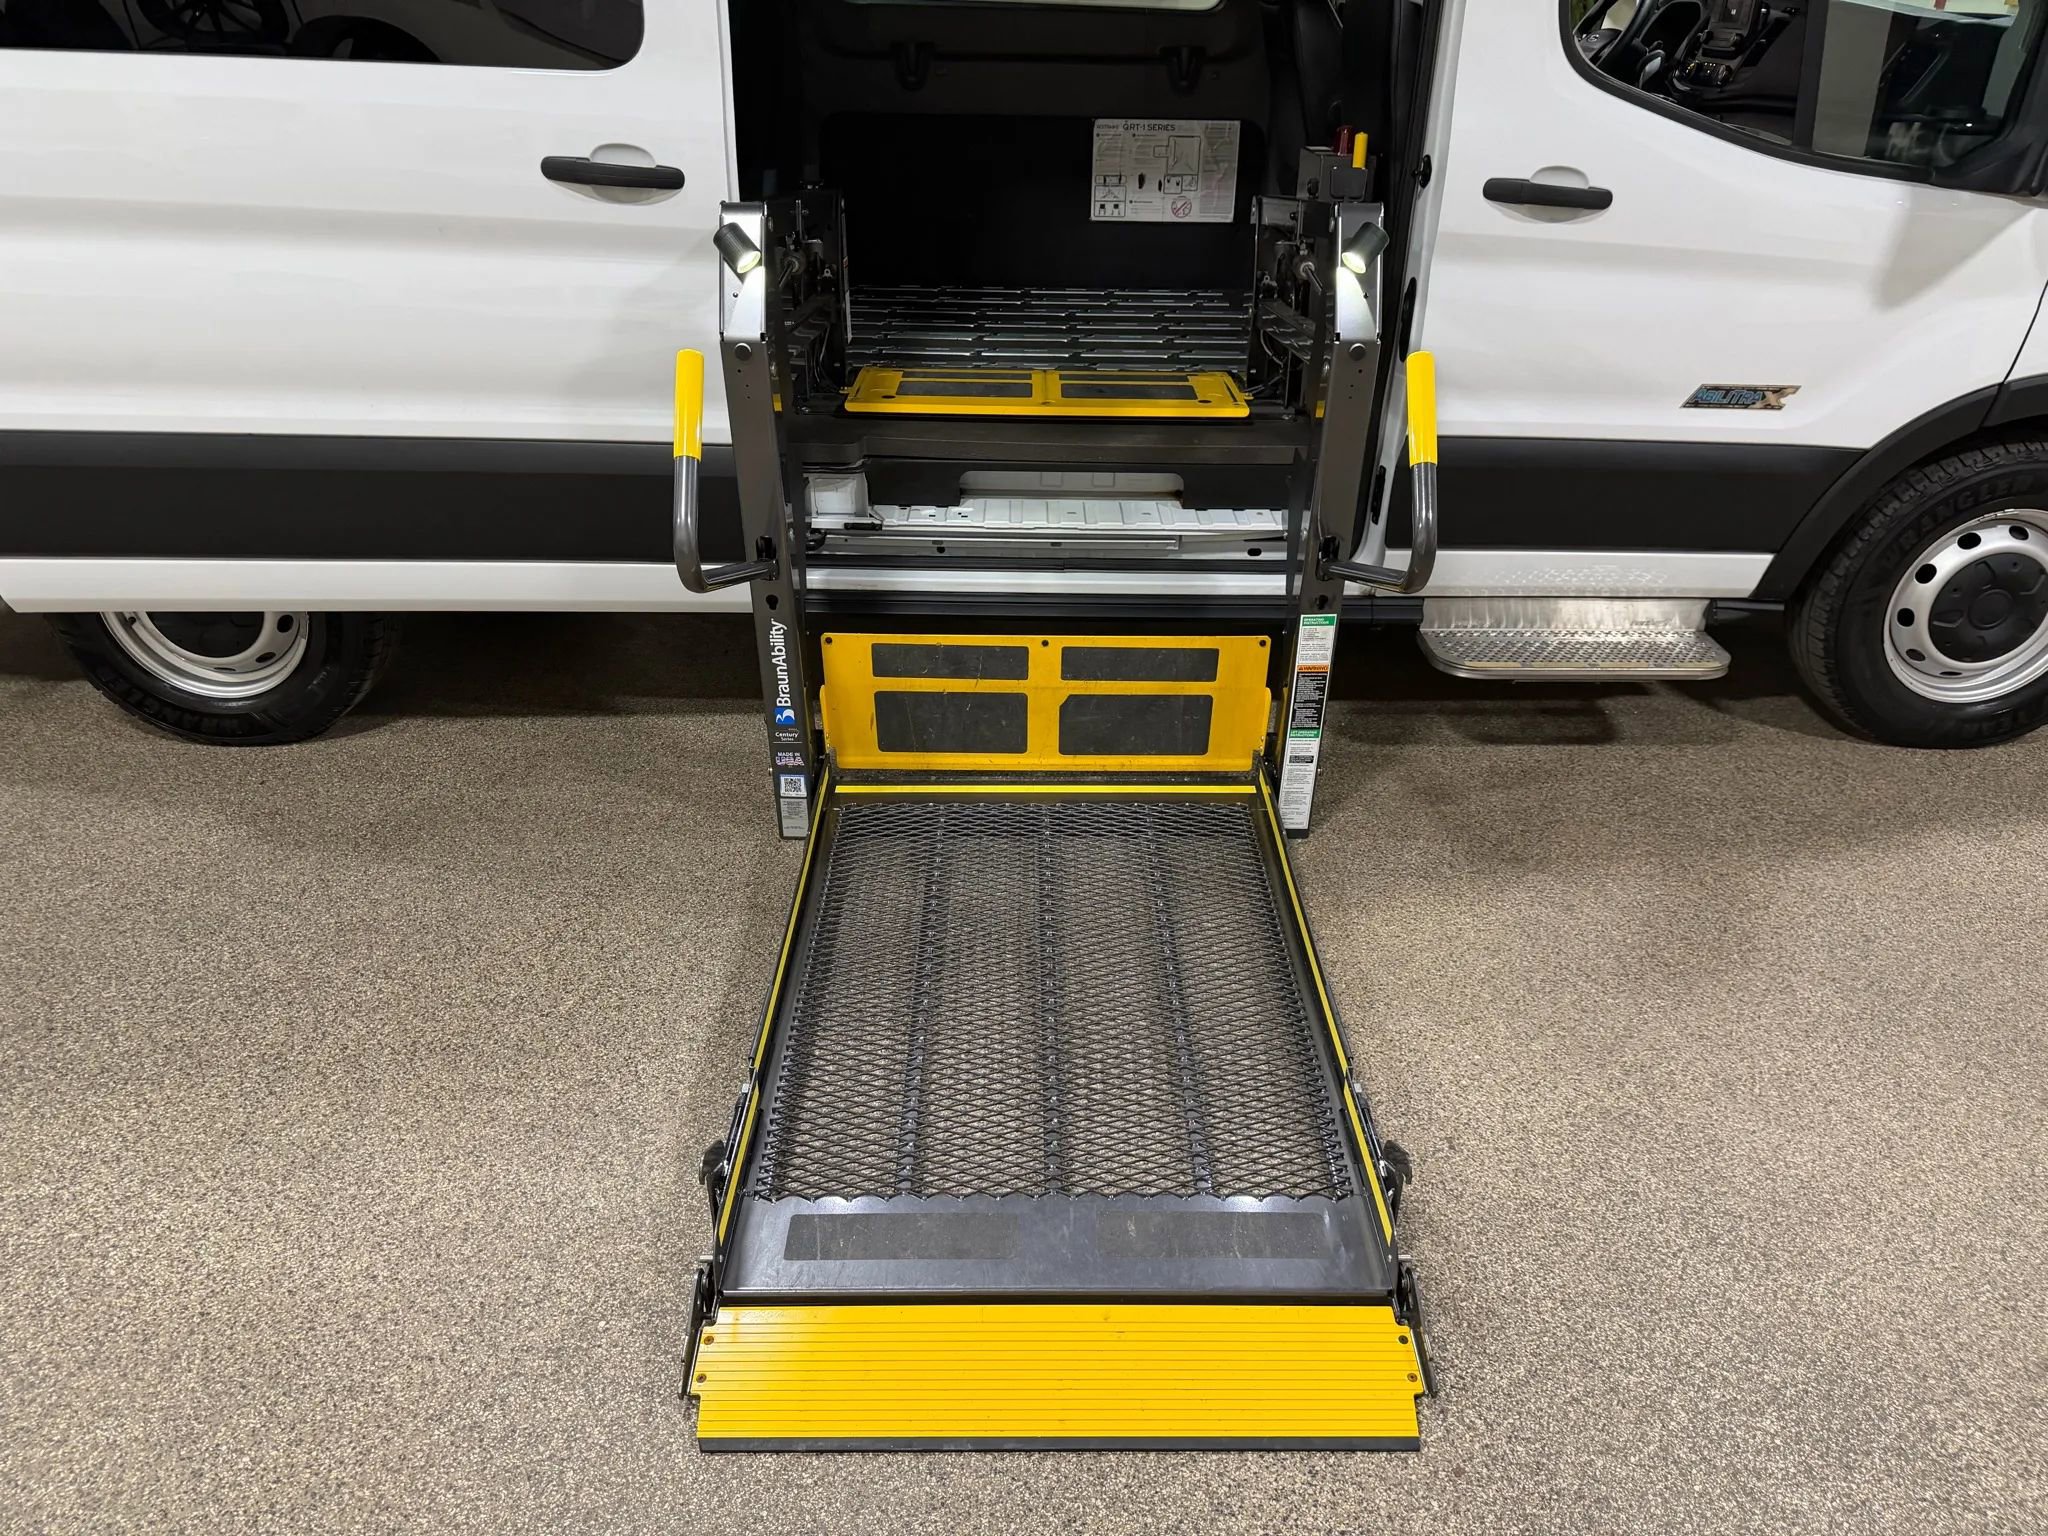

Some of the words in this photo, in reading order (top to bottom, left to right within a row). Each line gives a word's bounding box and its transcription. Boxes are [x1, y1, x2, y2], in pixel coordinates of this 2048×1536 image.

[1147, 123, 1176, 132] SERIES
[770, 618, 792, 706] BraunAbility
[775, 756, 805, 766] USA
